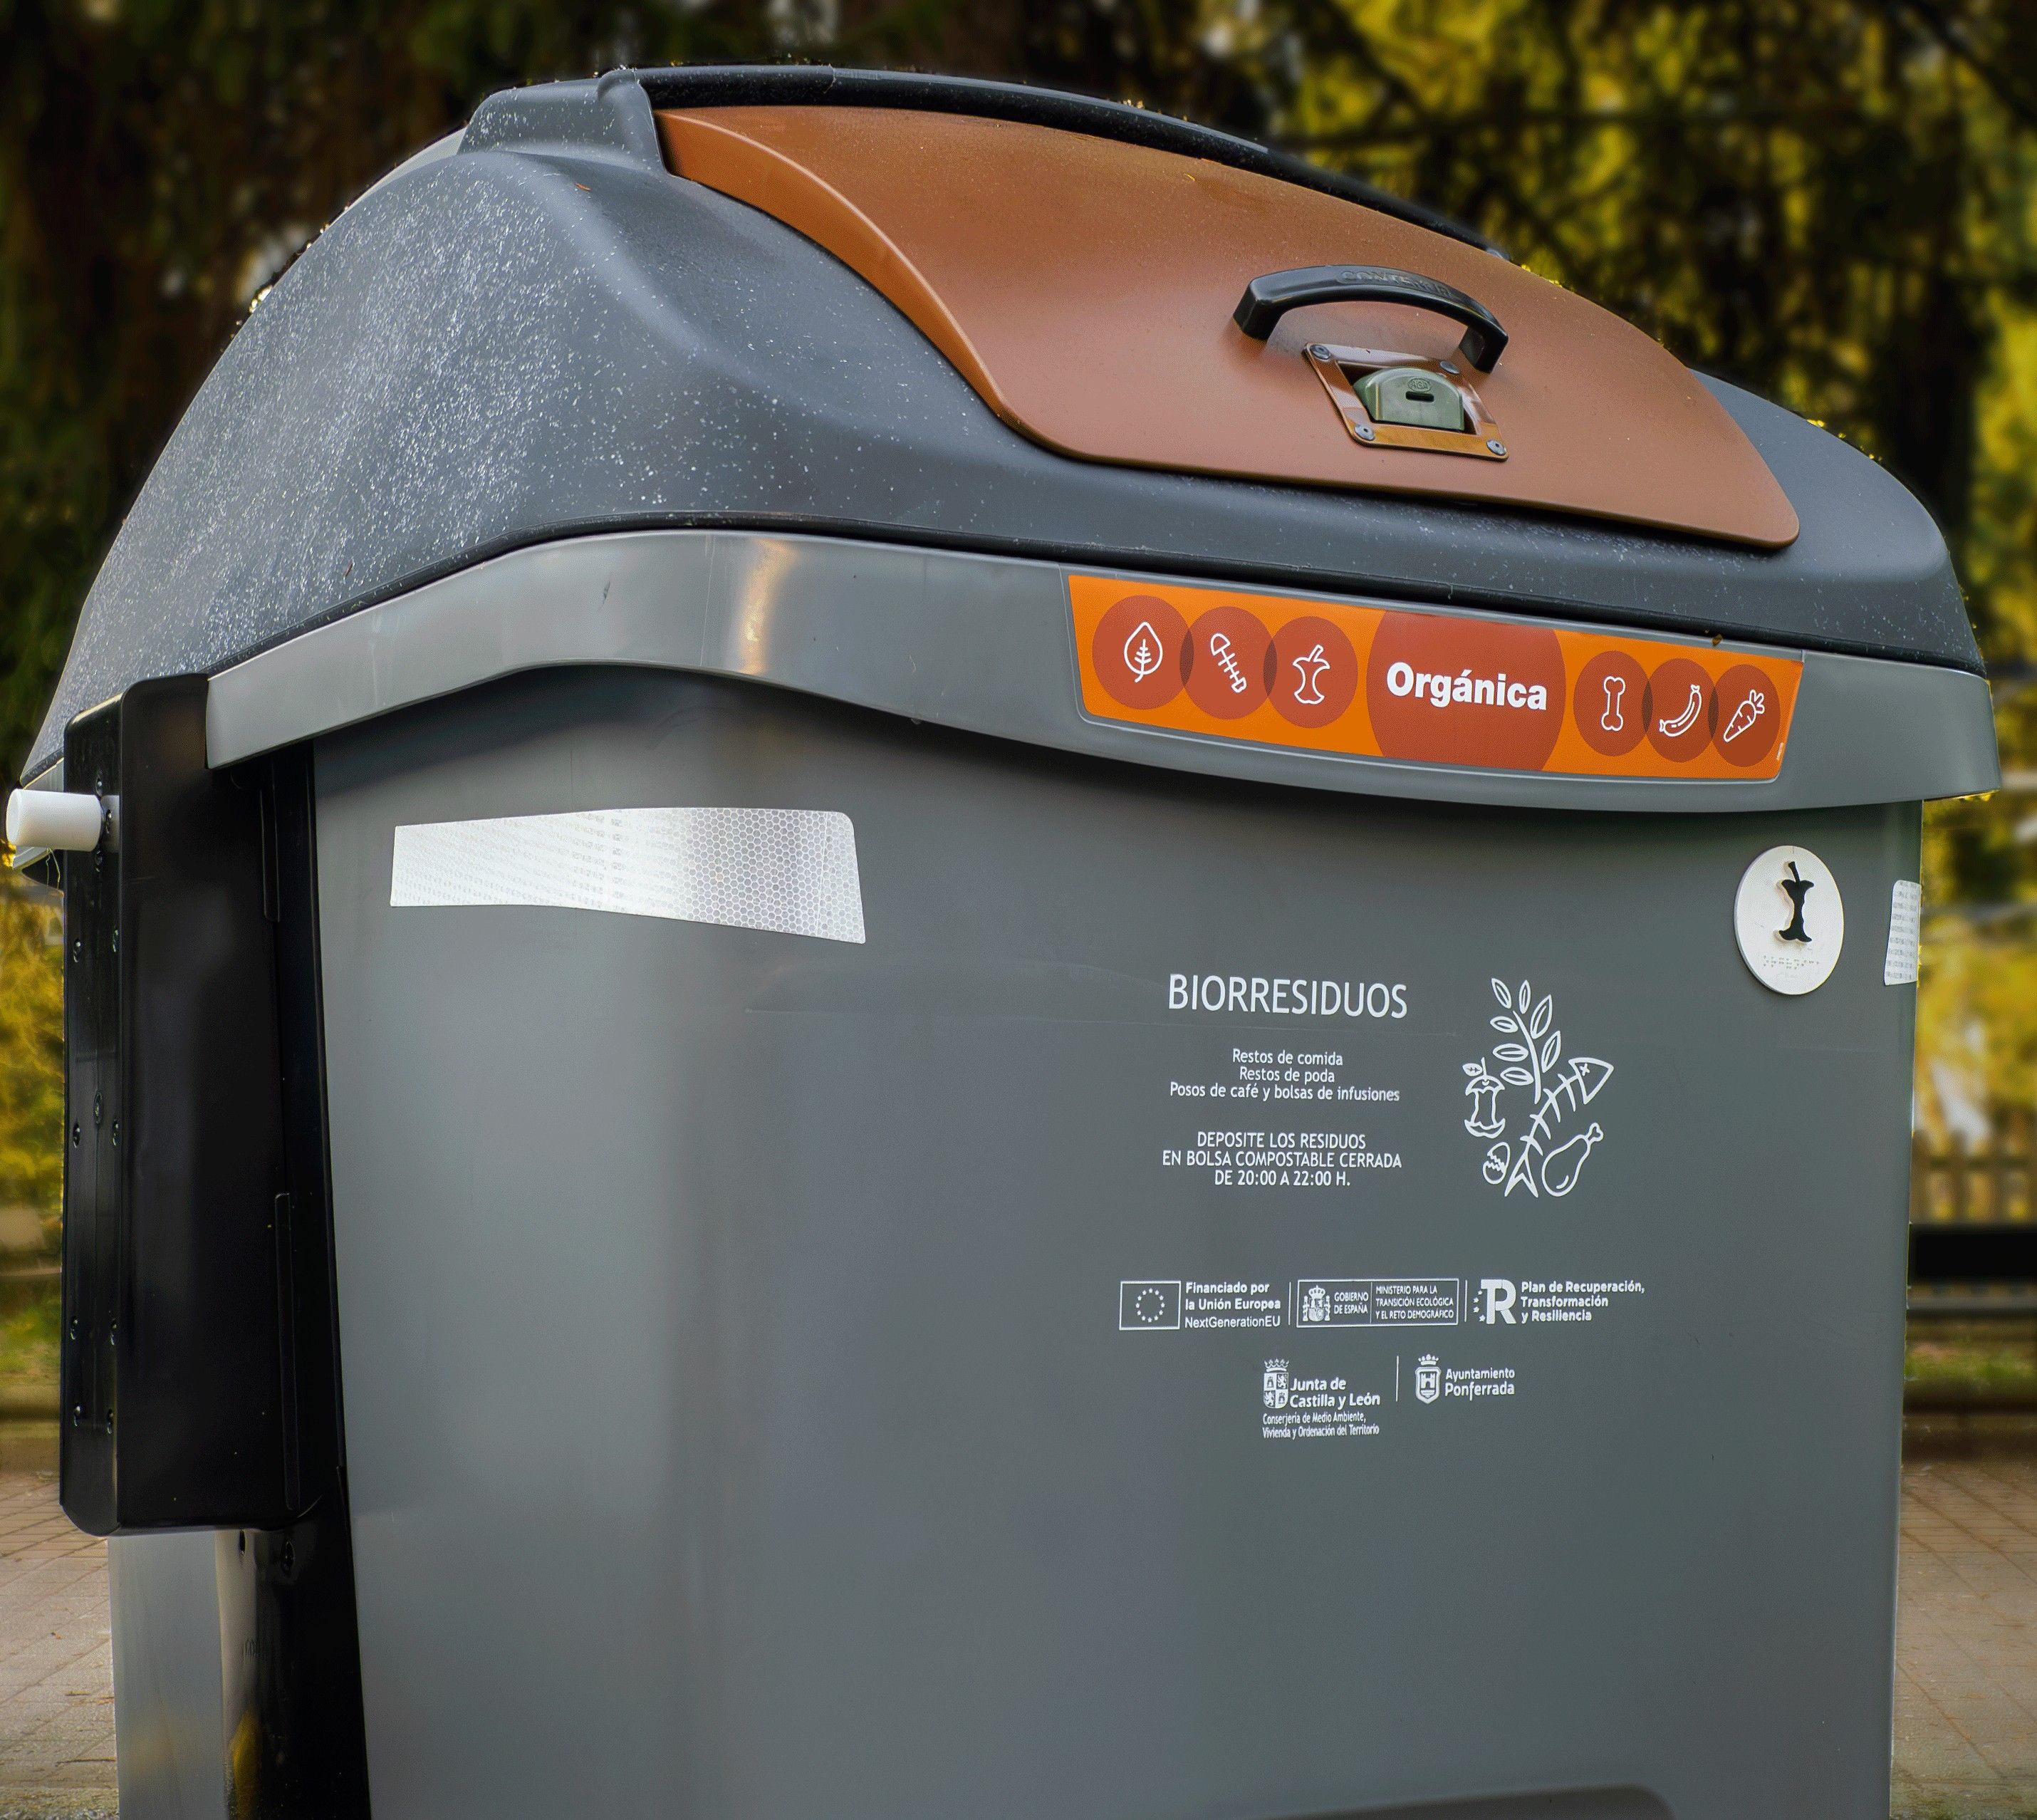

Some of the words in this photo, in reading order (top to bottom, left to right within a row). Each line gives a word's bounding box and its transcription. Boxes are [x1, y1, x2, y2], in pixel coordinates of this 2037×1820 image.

[1386, 662, 1547, 711] Orgánica
[1169, 973, 1407, 1019] BIORRESIDUOS
[1232, 1048, 1273, 1064] Restos
[1277, 1049, 1293, 1064] de
[1297, 1051, 1343, 1066] comida
[1239, 1066, 1281, 1081] Restos
[1284, 1067, 1301, 1082] de
[1304, 1068, 1335, 1086] poda
[1169, 1081, 1206, 1097] Posos
[1209, 1082, 1226, 1098] de
[1230, 1082, 1259, 1098] café
[1262, 1087, 1271, 1102] y
[1274, 1083, 1313, 1100] bolsas
[1317, 1085, 1333, 1101] de
[1337, 1086, 1400, 1101] infusiones
[1197, 1131, 1265, 1148] DEPOSITE
[1269, 1132, 1296, 1148] LOS
[1300, 1133, 1366, 1150] RESIDUOS
[1162, 1150, 1182, 1166] EN
[1187, 1150, 1232, 1167] BOLSA
[1235, 1150, 1335, 1168] COMPOSTABLE
[1339, 1152, 1402, 1168] CERRADA
[1214, 1169, 1234, 1185] DE
[1237, 1170, 1277, 1186] 20:00
[1279, 1170, 1290, 1186] A
[1293, 1170, 1332, 1186] 22:00
[1335, 1170, 1350, 1186] H.
[1185, 1281, 1248, 1294] Financiado
[1250, 1284, 1270, 1296] por
[1375, 1285, 1412, 1295] MINISTERIO
[1412, 1285, 1429, 1294] PARA
[1429, 1285, 1438, 1294] LA
[1521, 1281, 1546, 1293] Plan
[1548, 1280, 1563, 1293] de
[1565, 1279, 1645, 1295] Recuperación,
[1185, 1298, 1195, 1311] la
[1198, 1298, 1231, 1311] Unión
[1234, 1297, 1281, 1312] Europea
[1334, 1291, 1369, 1302] GOBIERNO
[1375, 1296, 1415, 1307] TRANSICIÓN
[1416, 1295, 1454, 1307] ECOLÓGICA
[1520, 1294, 1609, 1308] Transformación
[1333, 1304, 1343, 1314] DE
[1343, 1301, 1369, 1315] ESPAÑA
[1375, 1310, 1380, 1319] Y
[1381, 1310, 1388, 1320] EL
[1389, 1309, 1407, 1320] RETO
[1407, 1308, 1454, 1319] DEMOGRÁFICO
[1184, 1315, 1281, 1328] NextGenerationEU
[1521, 1312, 1529, 1324] y
[1531, 1309, 1592, 1322] Resiliencia
[1445, 1367, 1516, 1383] Ayuntamiento
[1290, 1378, 1328, 1391] Junta
[1330, 1376, 1347, 1390] de
[1444, 1380, 1515, 1401] Ponferrada
[1289, 1393, 1335, 1408] Castilla
[1337, 1395, 1347, 1410] y
[1349, 1392, 1381, 1406] León
[1301, 1412, 1311, 1424] de
[1312, 1411, 1333, 1423] Medio
[1333, 1410, 1367, 1424] Ambiente,
[1262, 1425, 1291, 1439] Vivienda
[1292, 1428, 1297, 1440] y
[1298, 1423, 1335, 1437] Ordenación
[1336, 1424, 1348, 1436] del
[1348, 1423, 1380, 1436] Territorio
